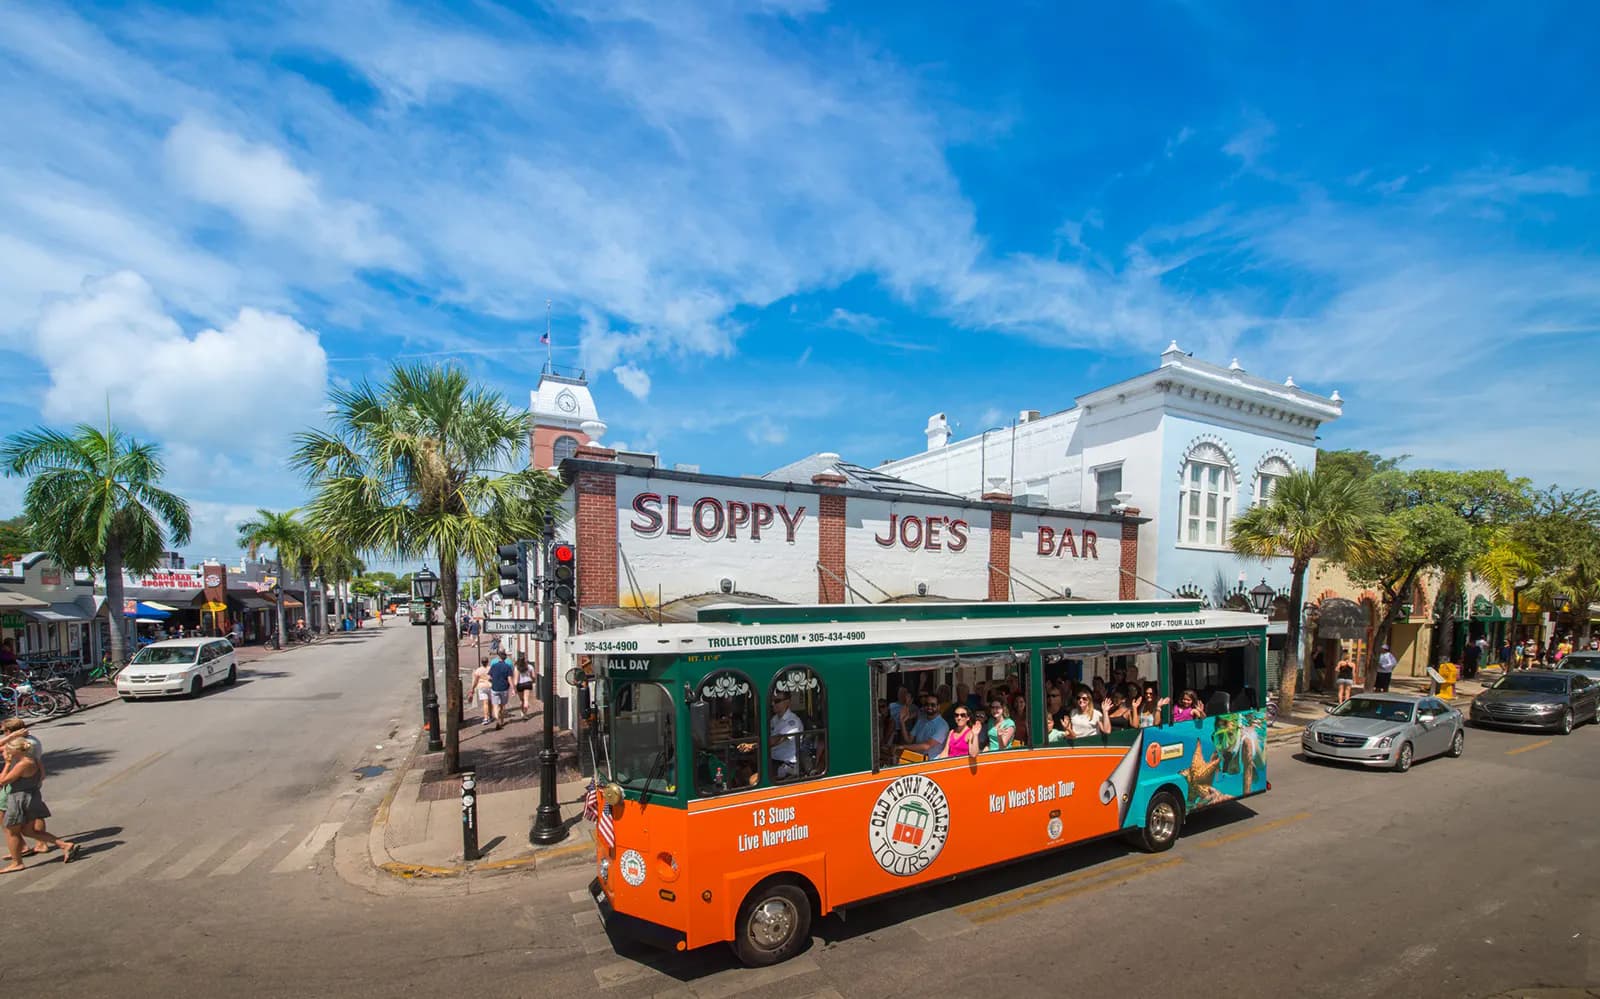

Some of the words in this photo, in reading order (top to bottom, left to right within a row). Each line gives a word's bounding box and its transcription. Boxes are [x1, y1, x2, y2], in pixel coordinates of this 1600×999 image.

[630, 492, 807, 545] SLOPPY
[875, 513, 971, 553] JOE'S
[1037, 526, 1099, 560] BAR
[142, 580, 175, 588] SPORTS
[495, 622, 518, 630] Duval
[1110, 621, 1125, 630] HOP
[1126, 621, 1135, 629] ON
[1136, 620, 1150, 629] HOP
[1151, 620, 1162, 628] OFF
[1167, 619, 1183, 627] TOUR
[1183, 618, 1194, 626] ALL
[1194, 618, 1206, 626] DAY
[584, 640, 638, 652] 305-434-4900
[707, 633, 799, 648] TROLLEYTOURS.COM
[809, 631, 866, 643] 305-434-4900
[608, 660, 627, 670] ALL
[629, 659, 650, 671] DAY
[989, 794, 1006, 814] Key
[1008, 787, 1036, 809] West's
[1037, 783, 1056, 802] Best
[1058, 780, 1075, 798] Tour
[752, 808, 766, 827] 13
[768, 806, 796, 824] Stops
[871, 799, 891, 827] OLD
[886, 776, 922, 802] TOWN
[923, 781, 948, 843] TROLLEY
[738, 834, 759, 852] Live
[762, 824, 809, 847] Narration
[875, 837, 930, 875] TOURS
